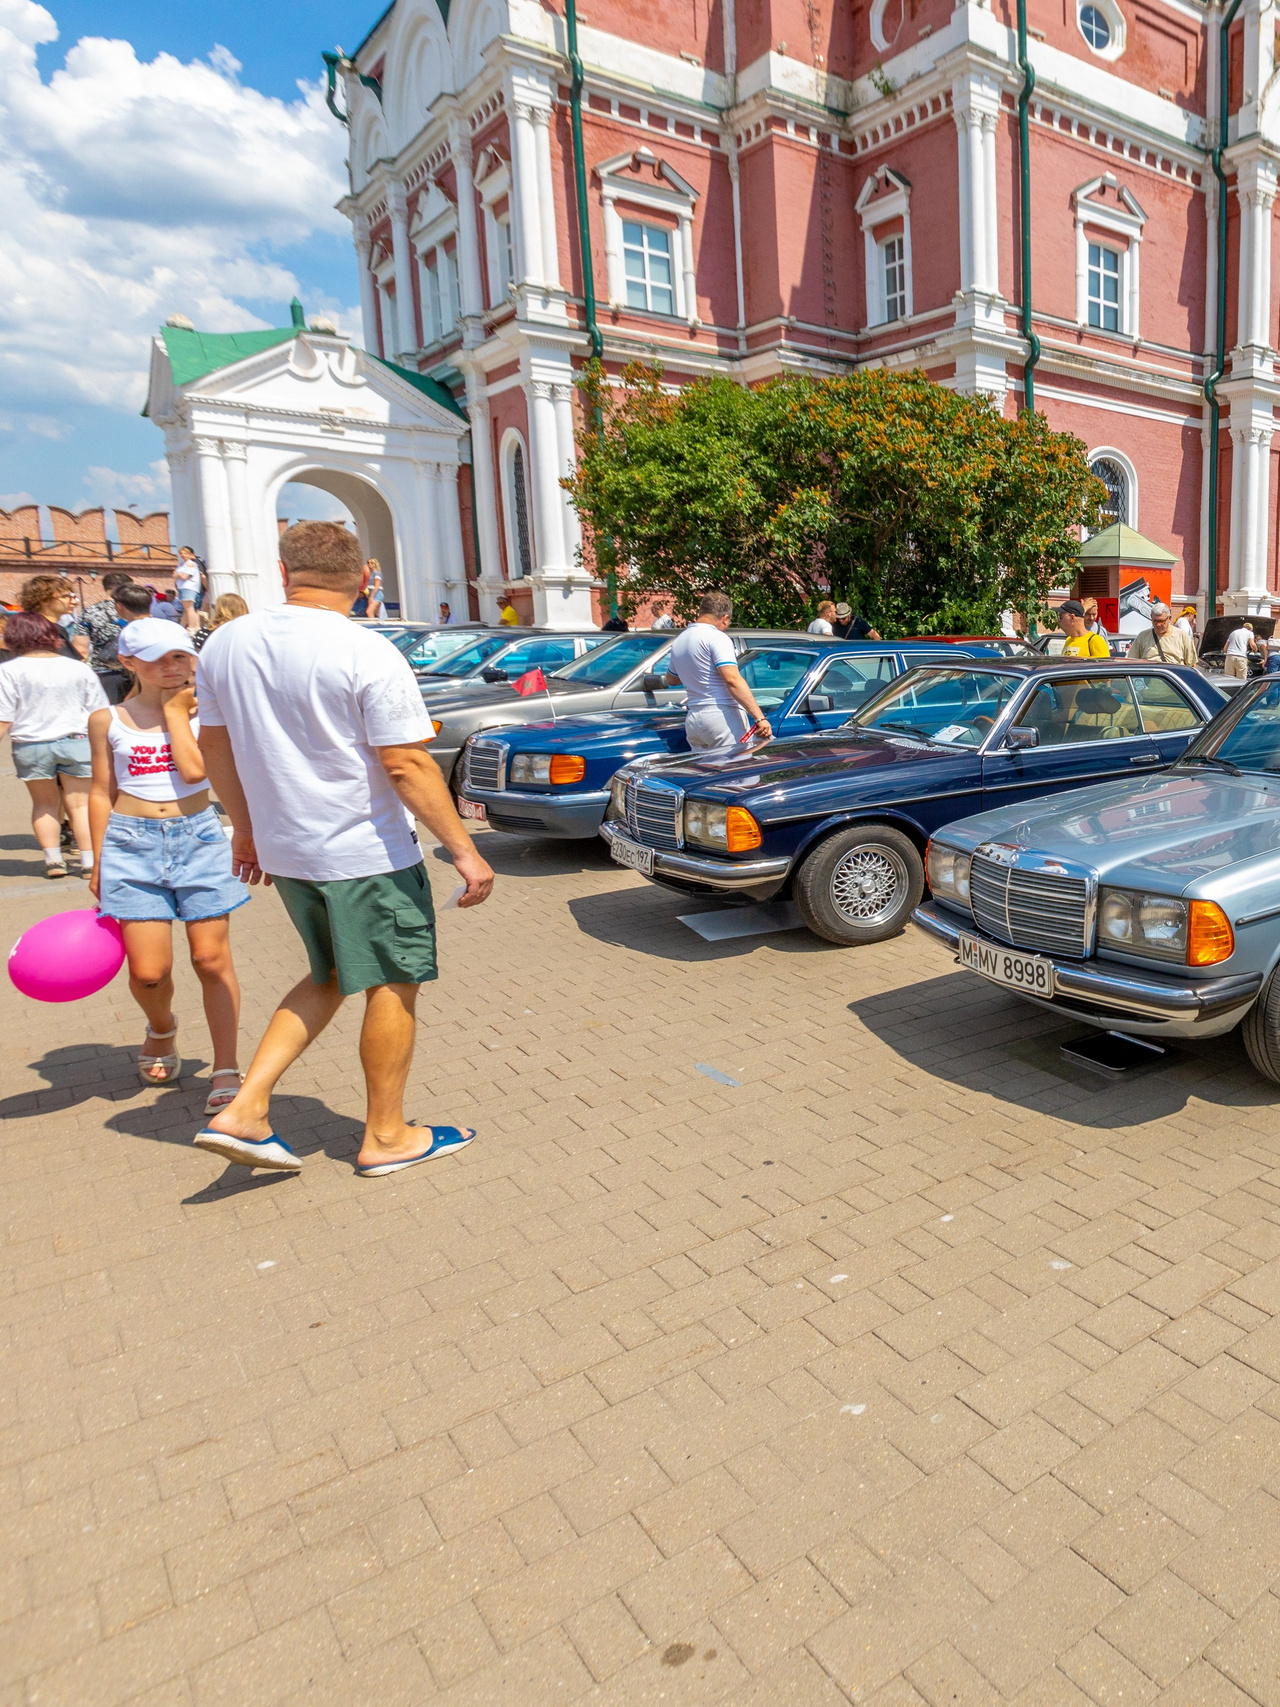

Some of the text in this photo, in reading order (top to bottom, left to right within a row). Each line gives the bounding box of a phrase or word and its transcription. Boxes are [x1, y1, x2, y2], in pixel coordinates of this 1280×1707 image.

[130, 745, 157, 755] YOU
[128, 754, 174, 764] THE MA
[128, 763, 178, 777] CHARAC
[636, 849, 649, 865] 197
[1003, 956, 1046, 989] 8998
